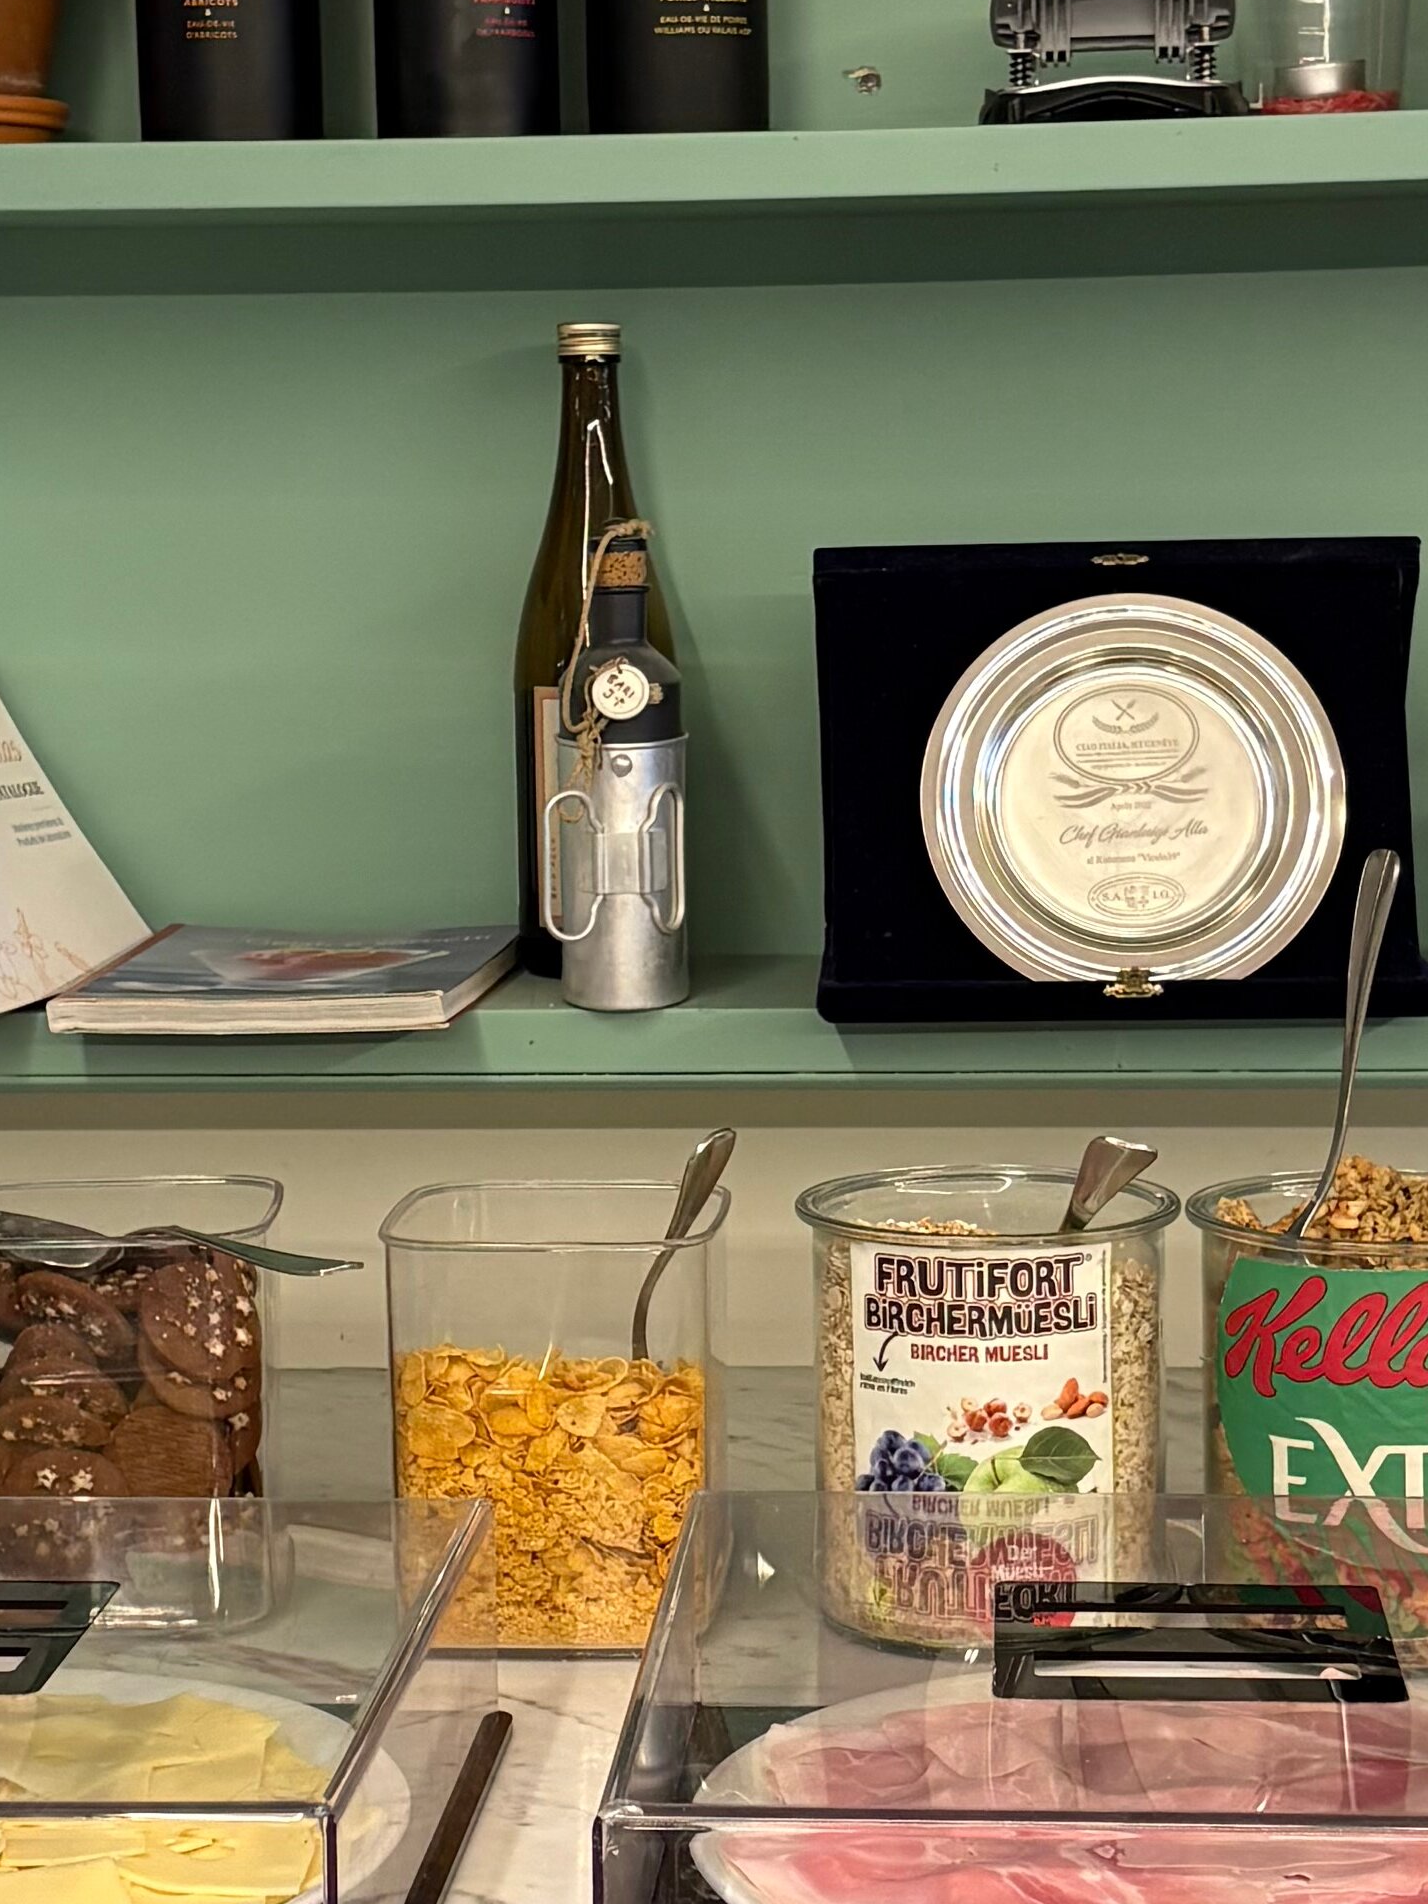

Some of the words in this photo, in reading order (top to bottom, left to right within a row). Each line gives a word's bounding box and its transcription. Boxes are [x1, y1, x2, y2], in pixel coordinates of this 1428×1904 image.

[1059, 824, 1100, 849] Chef
[910, 1343, 980, 1363] BIRCHER
[985, 1343, 1049, 1363] MUESLI
